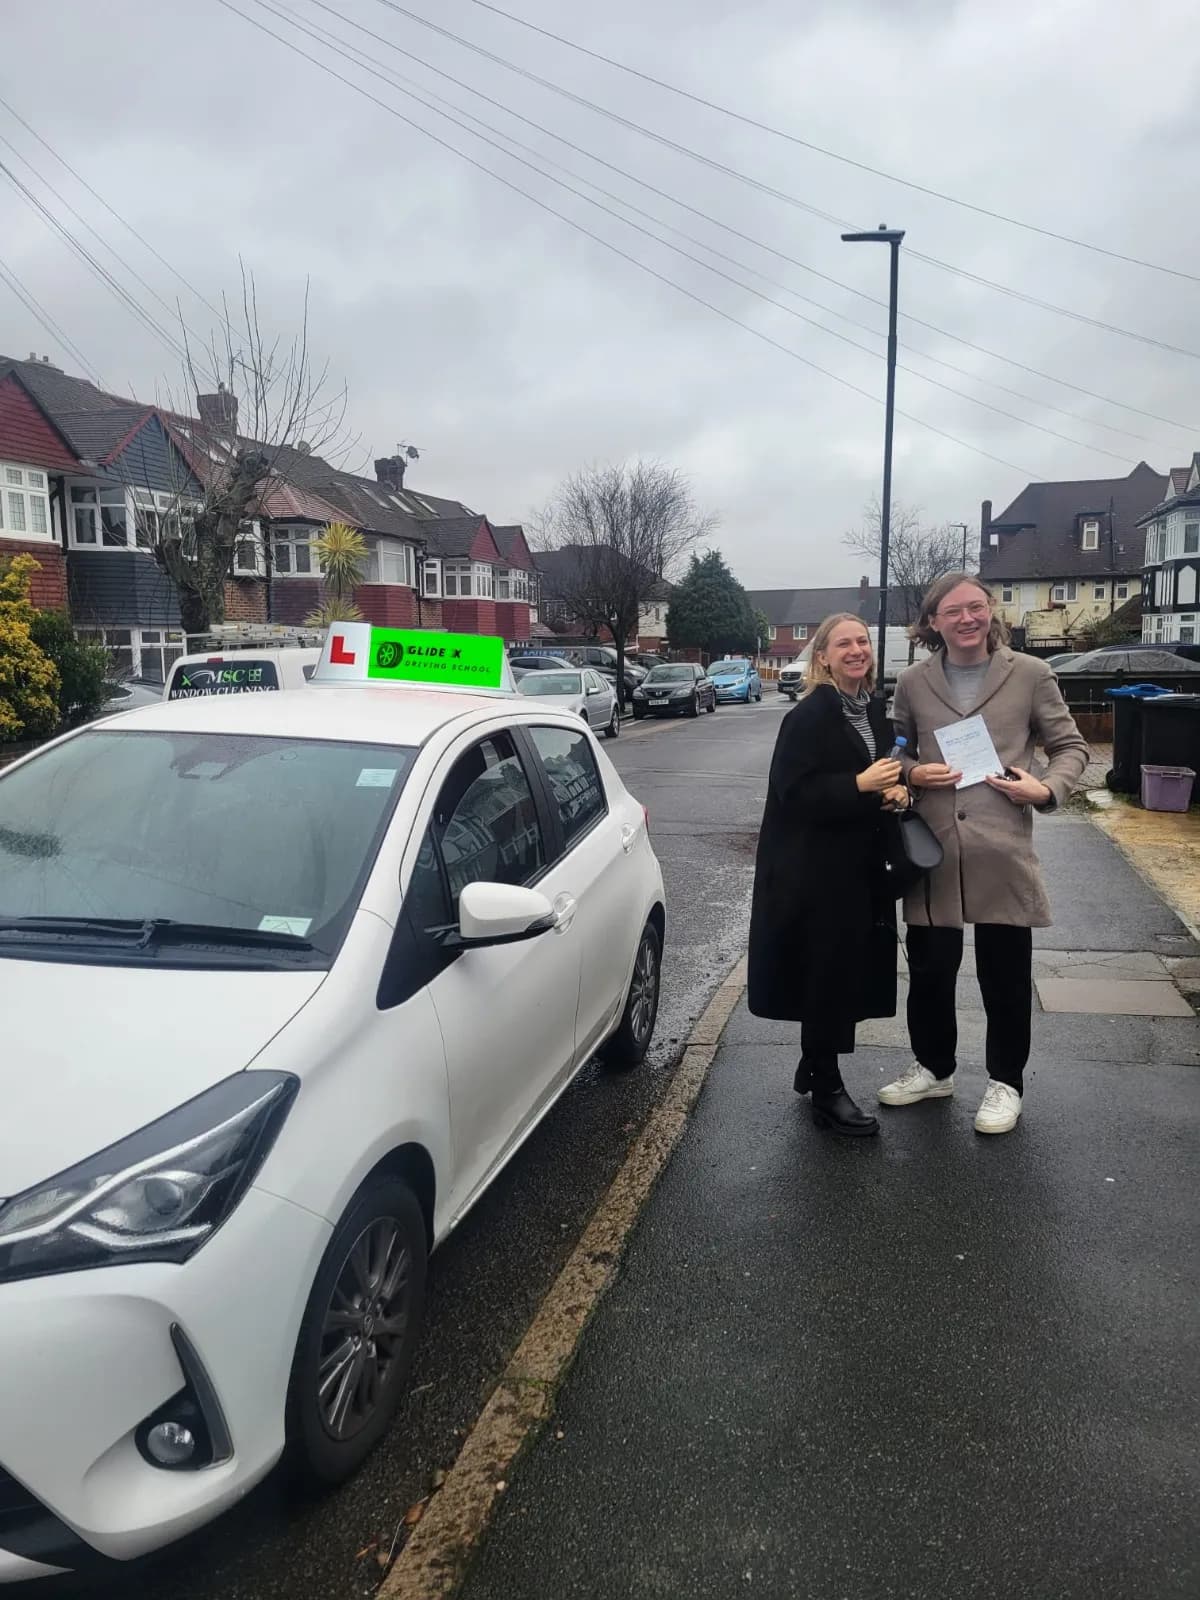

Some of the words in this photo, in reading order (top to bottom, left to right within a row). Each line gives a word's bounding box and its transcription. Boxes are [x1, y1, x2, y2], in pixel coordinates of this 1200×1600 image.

[330, 636, 355, 664] L
[408, 645, 446, 657] GLIDE
[452, 649, 462, 658] X
[405, 660, 446, 670] DRIVING
[452, 664, 491, 673] SCHOOL
[206, 669, 245, 684] MSC
[171, 688, 215, 698] WINDOW
